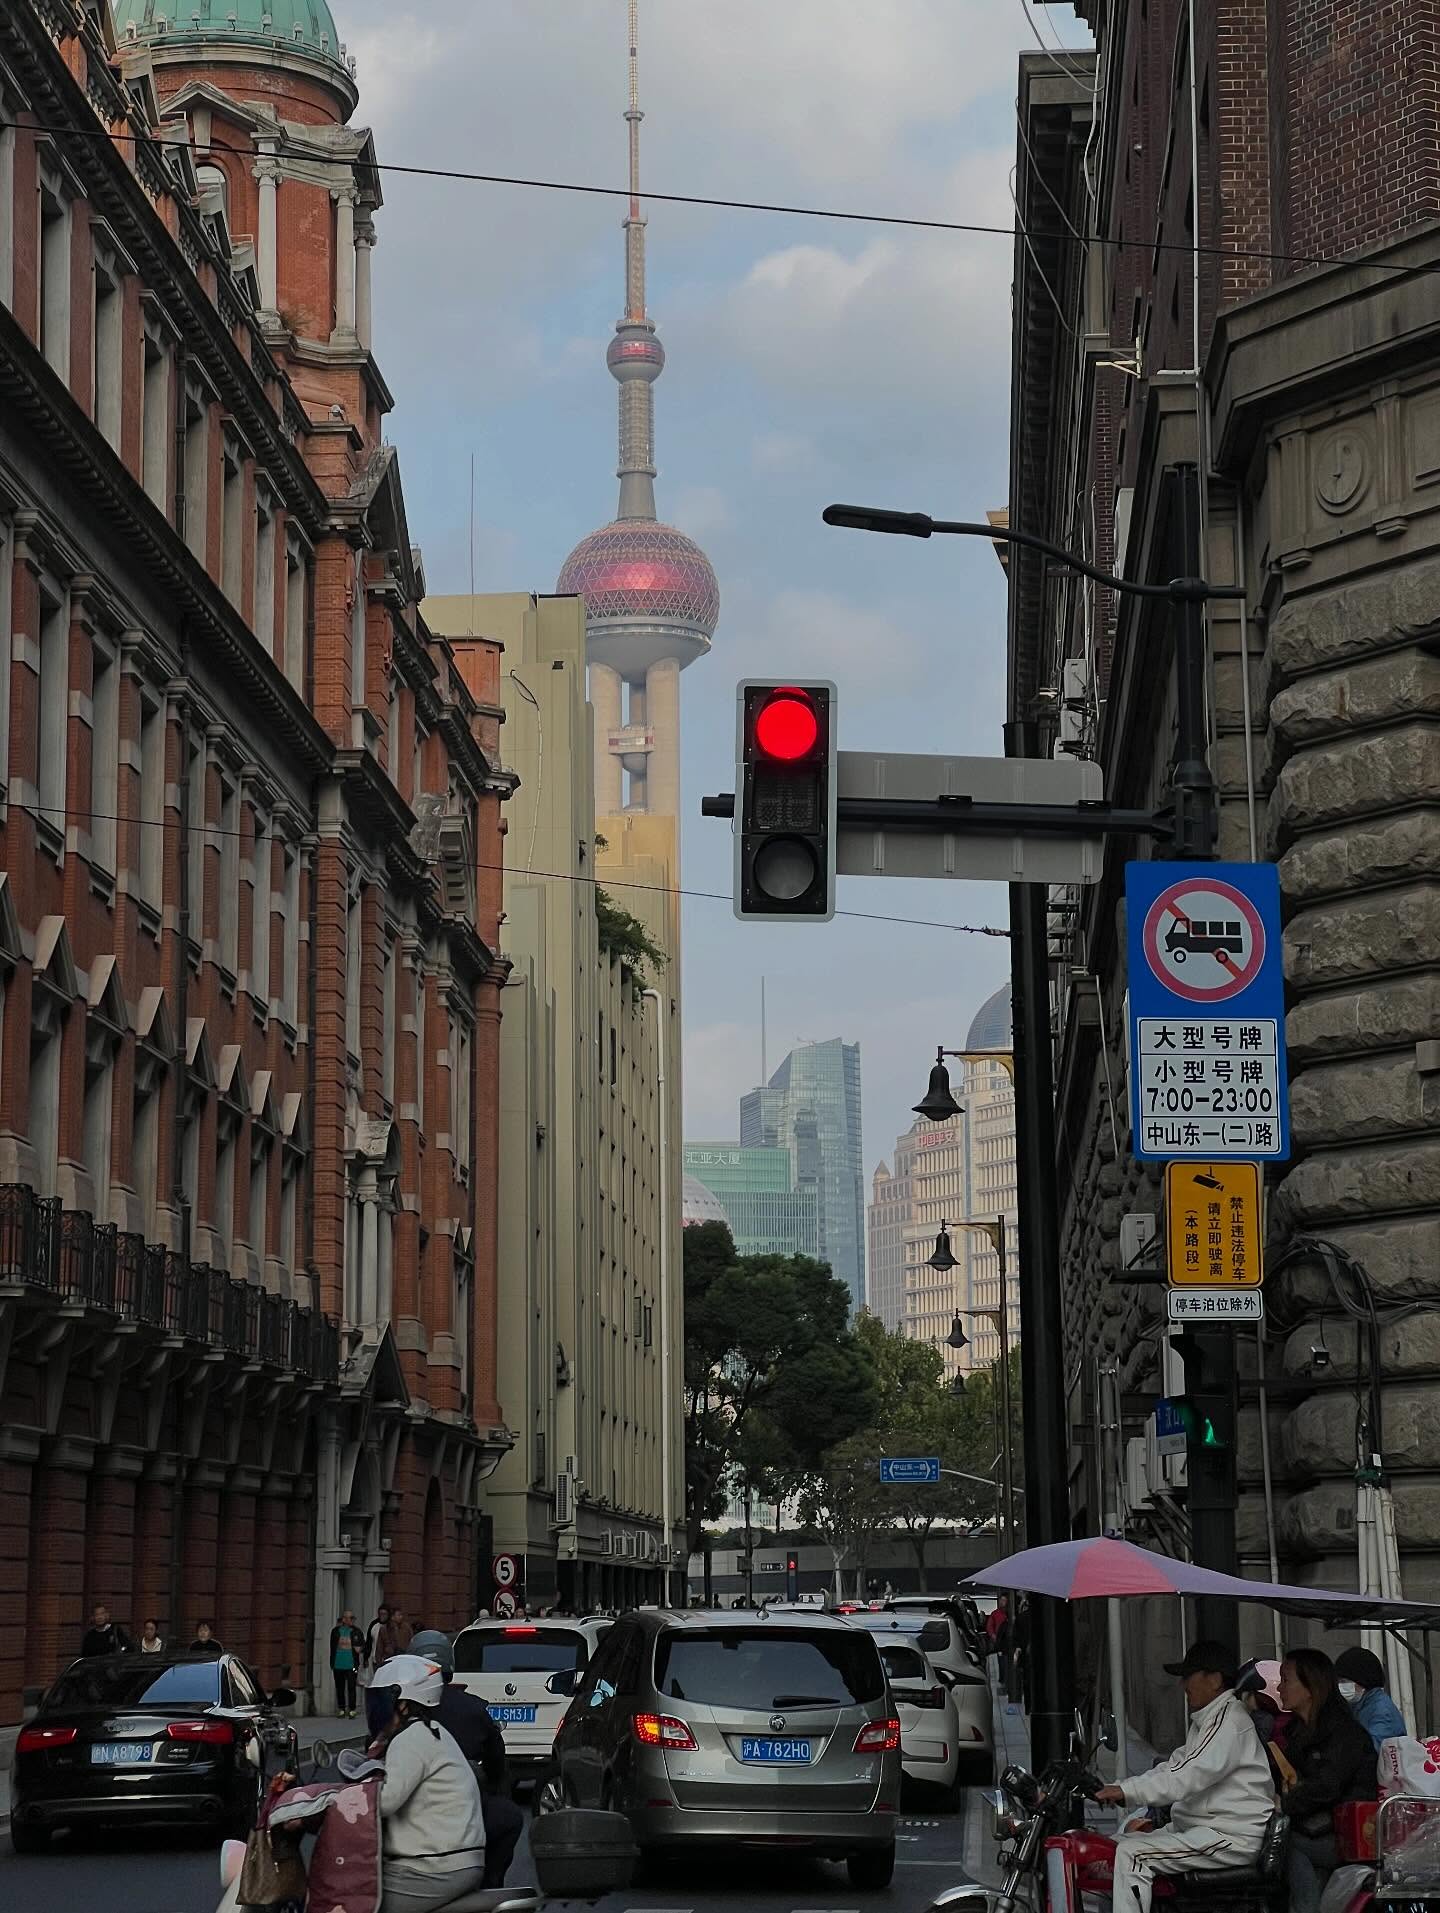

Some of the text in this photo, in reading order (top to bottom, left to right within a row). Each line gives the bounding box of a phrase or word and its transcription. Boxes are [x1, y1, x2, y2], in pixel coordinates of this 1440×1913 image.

[1154, 1026, 1262, 1050] 大型号牌
[1155, 1060, 1263, 1084] 小型号牌
[1147, 1088, 1272, 1112] 7:00-23:00
[919, 1130, 954, 1147] 中国平安
[1148, 1122, 1272, 1146] 中山东一(二)路
[686, 1152, 741, 1165] 汇亚大厦
[1185, 1209, 1199, 1272] (本路段)
[1208, 1202, 1222, 1276] 请立即驶离
[1230, 1197, 1246, 1280] 禁止违法停车
[1175, 1297, 1256, 1312] 停车泊位除外
[501, 1561, 510, 1580] 5
